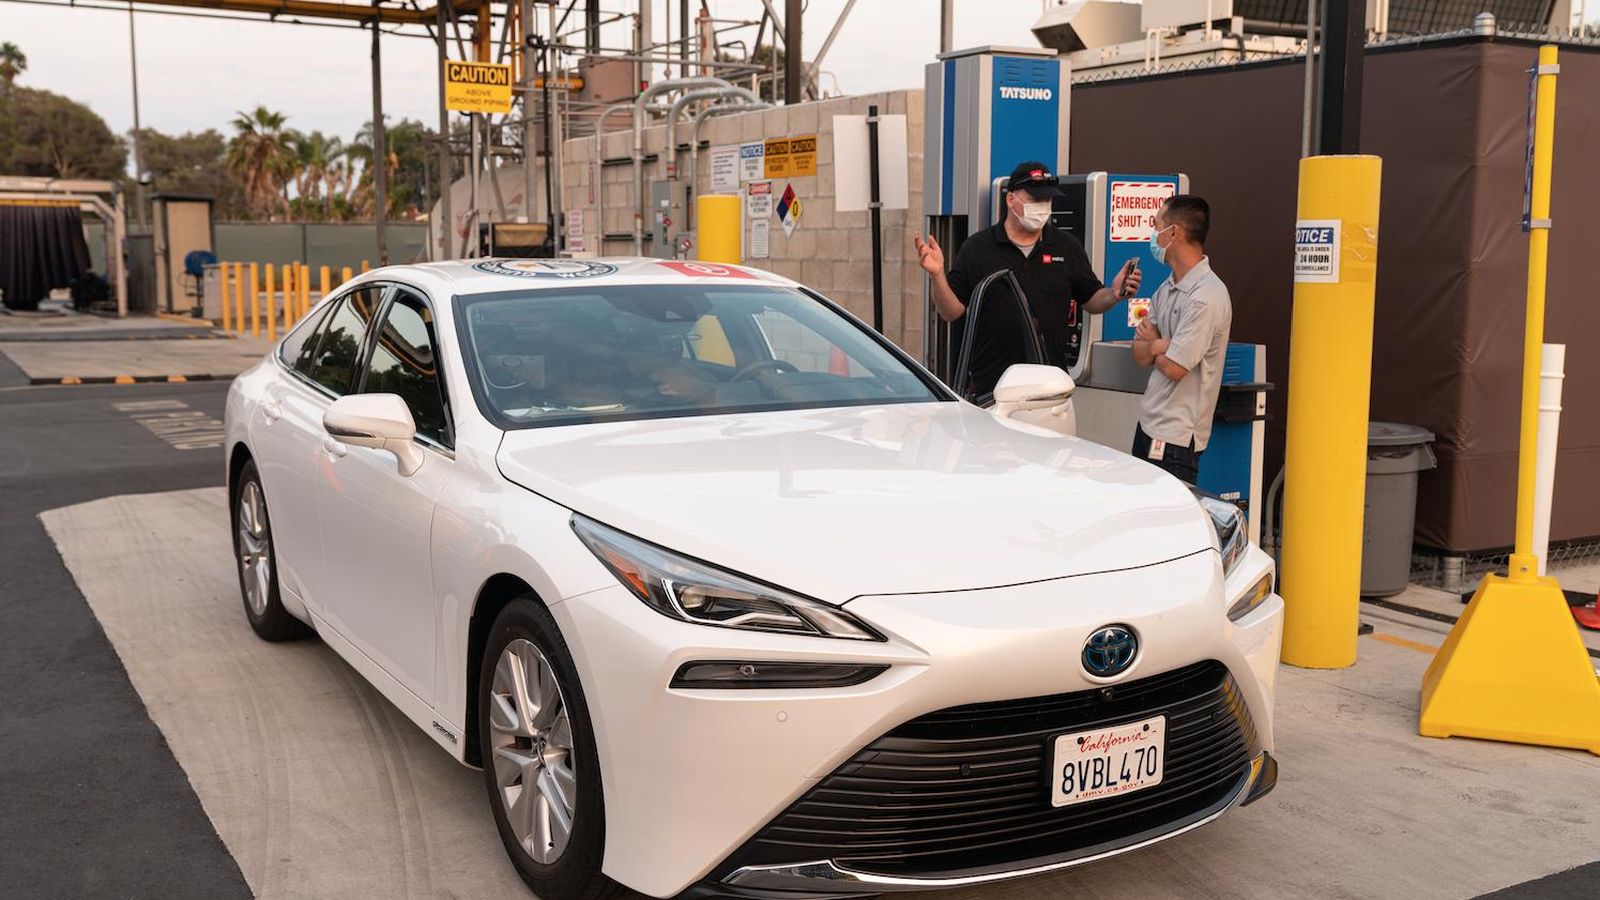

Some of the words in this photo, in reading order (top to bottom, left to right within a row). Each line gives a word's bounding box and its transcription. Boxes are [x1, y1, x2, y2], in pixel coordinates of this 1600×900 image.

[451, 65, 506, 84] CAUTION
[1000, 87, 1052, 100] TATSUNO
[742, 146, 763, 157] NOTICE
[1115, 196, 1166, 209] EMERGENC
[1296, 229, 1330, 243] OTICE
[1308, 255, 1329, 263] HOUR
[1080, 731, 1147, 753] California
[1061, 745, 1158, 795] 8VBL470
[1082, 781, 1139, 797] dmv.ca.gov
